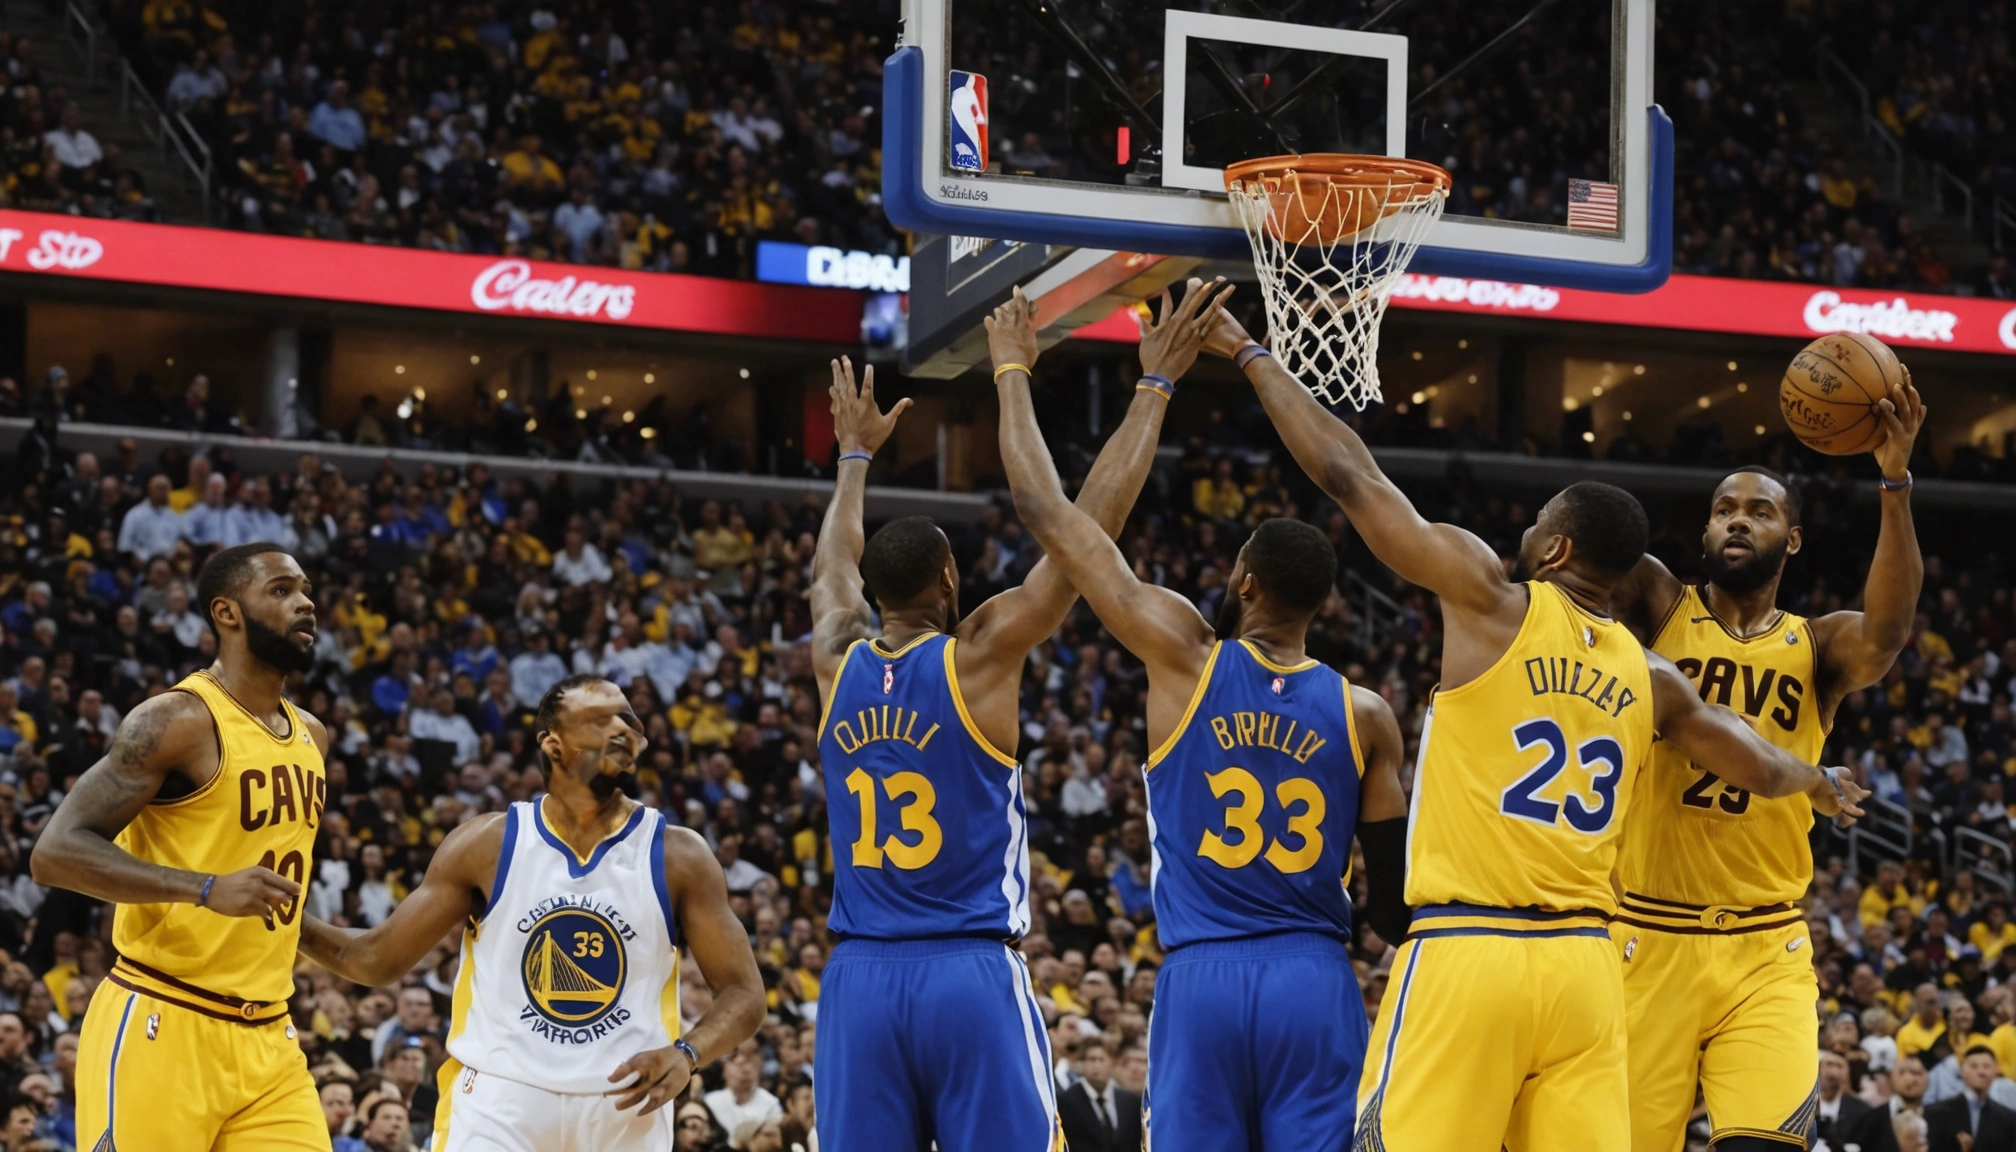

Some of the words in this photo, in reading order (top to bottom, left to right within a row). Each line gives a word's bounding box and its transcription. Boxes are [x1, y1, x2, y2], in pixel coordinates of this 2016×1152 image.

[845, 767, 943, 870] 13
[1197, 767, 1326, 874] 33
[1500, 717, 1623, 834] 23
